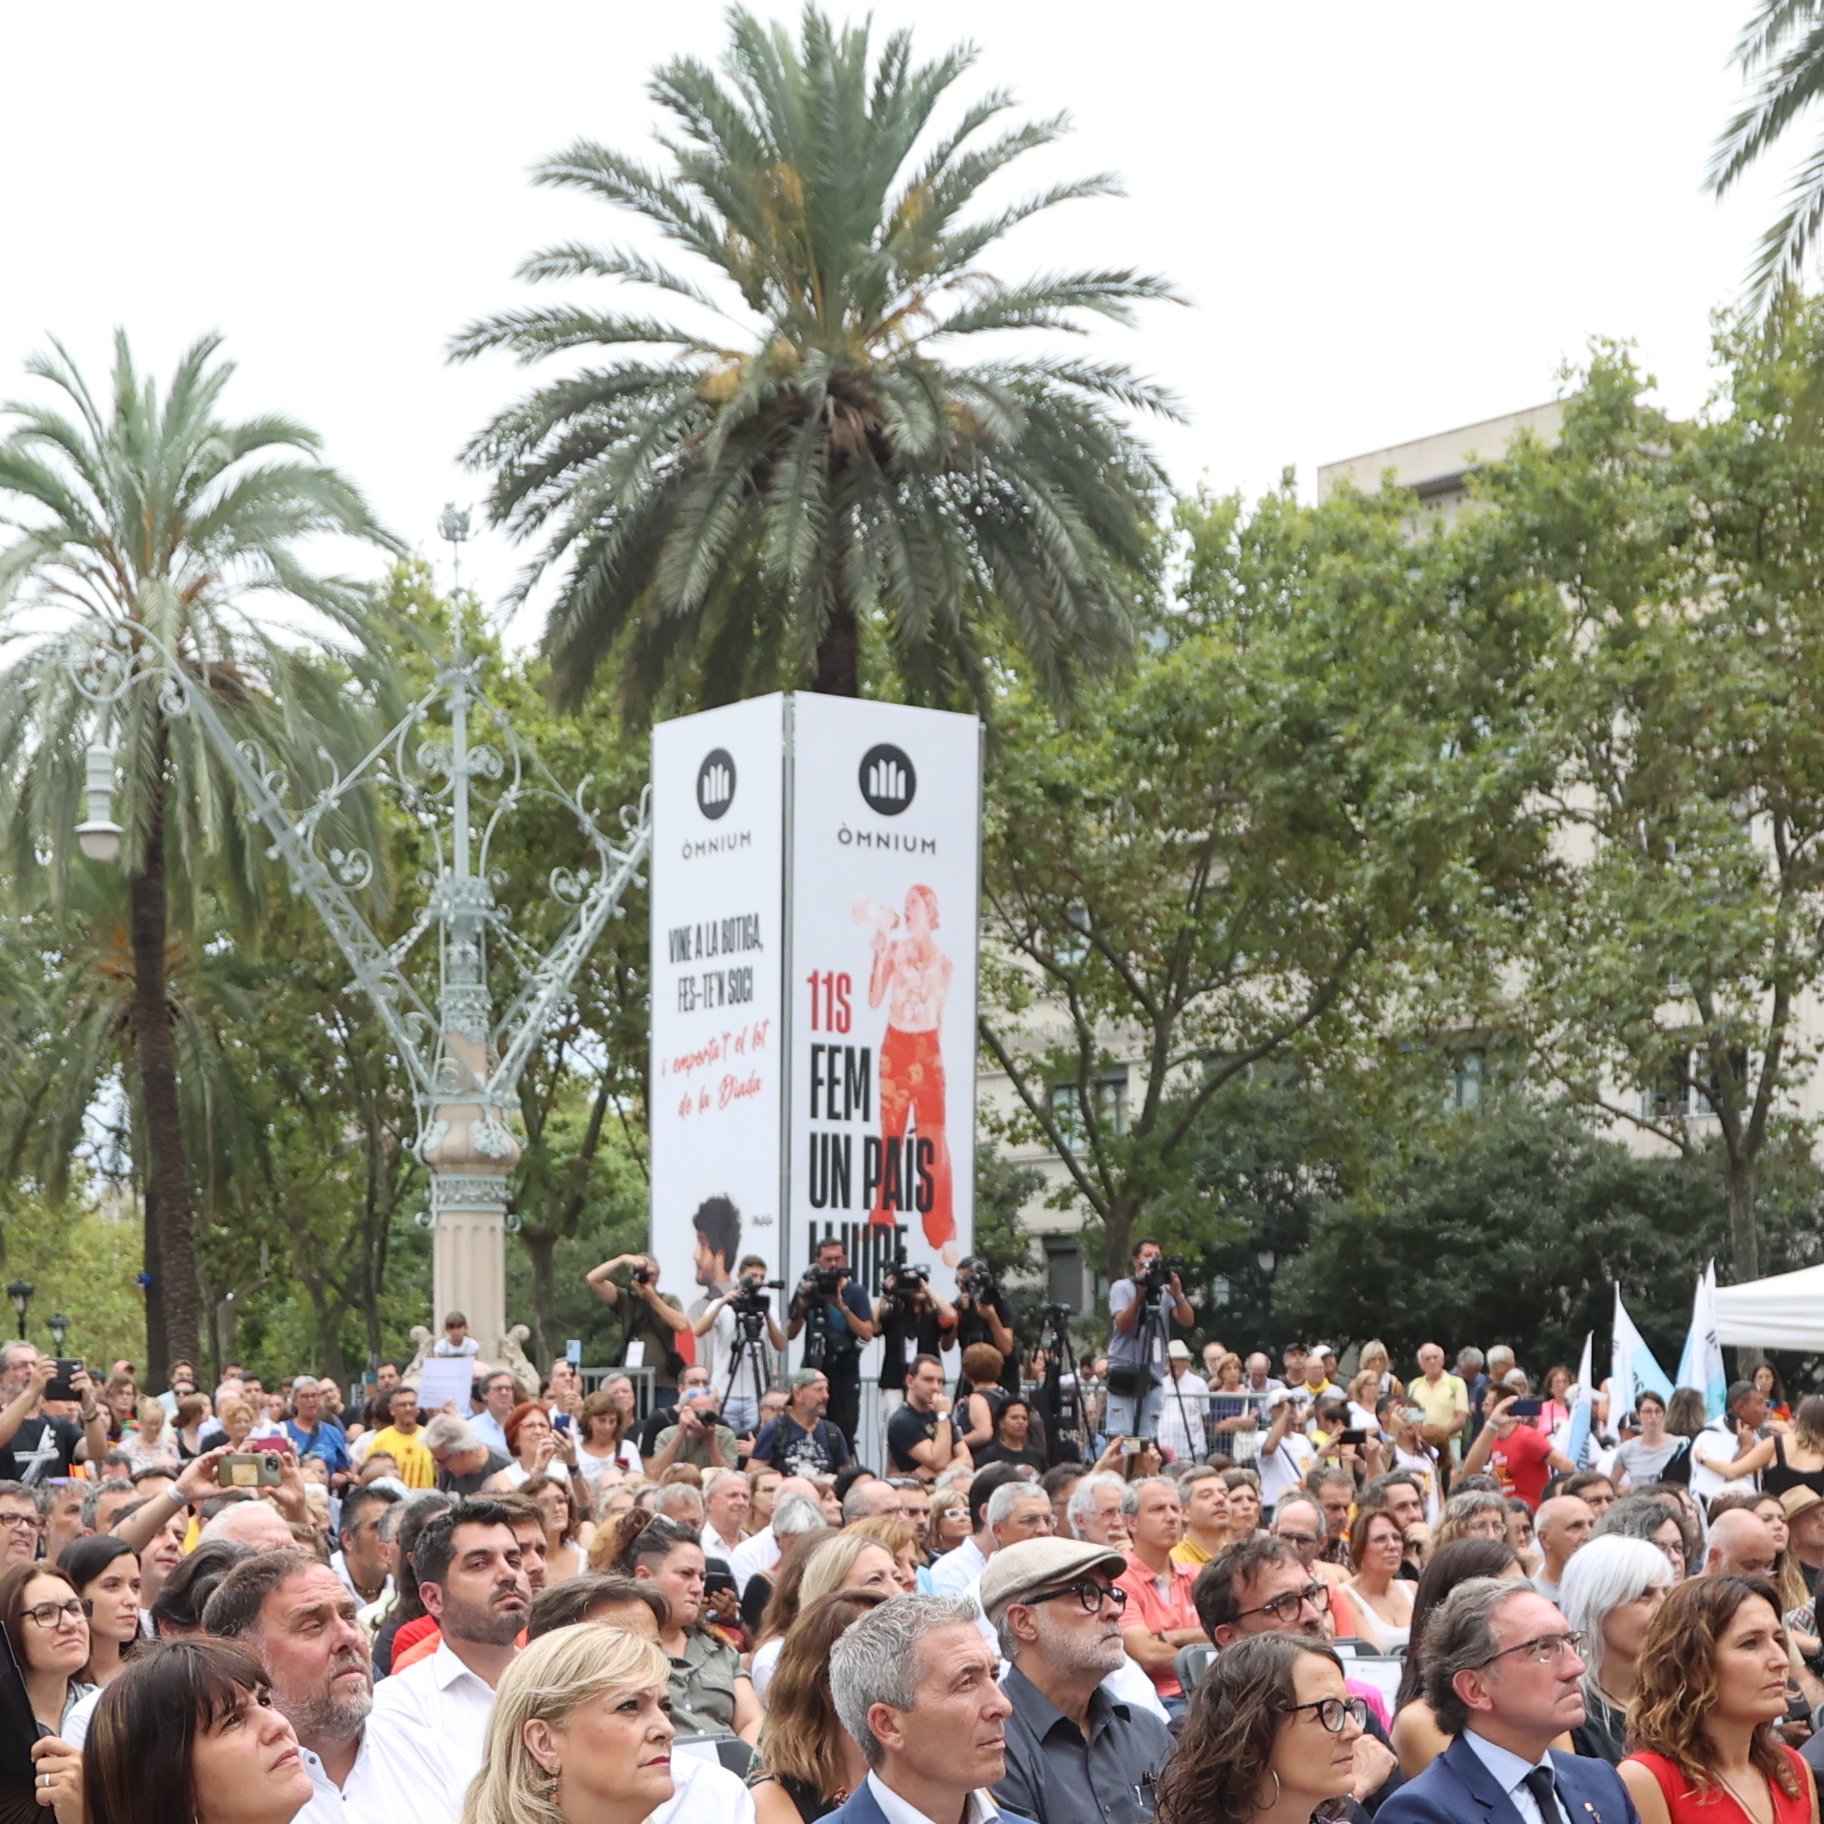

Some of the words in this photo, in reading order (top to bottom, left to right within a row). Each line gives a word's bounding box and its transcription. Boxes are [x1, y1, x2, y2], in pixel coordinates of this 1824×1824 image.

[682, 831, 752, 860] ÒMNIUM
[837, 821, 936, 855] ÒMNIUM
[669, 922, 692, 964] VINE
[695, 924, 703, 959] A
[706, 920, 719, 957] LA
[721, 912, 764, 955] BOTIGA,
[727, 965, 755, 1005] SOCI
[807, 969, 851, 1034] 11S
[734, 1025, 747, 1055] el
[678, 1091, 692, 1120] de
[698, 1085, 711, 1114] la
[810, 1043, 871, 1122] FEM
[809, 1132, 852, 1210] UN
[863, 1127, 935, 1213] PAÍS
